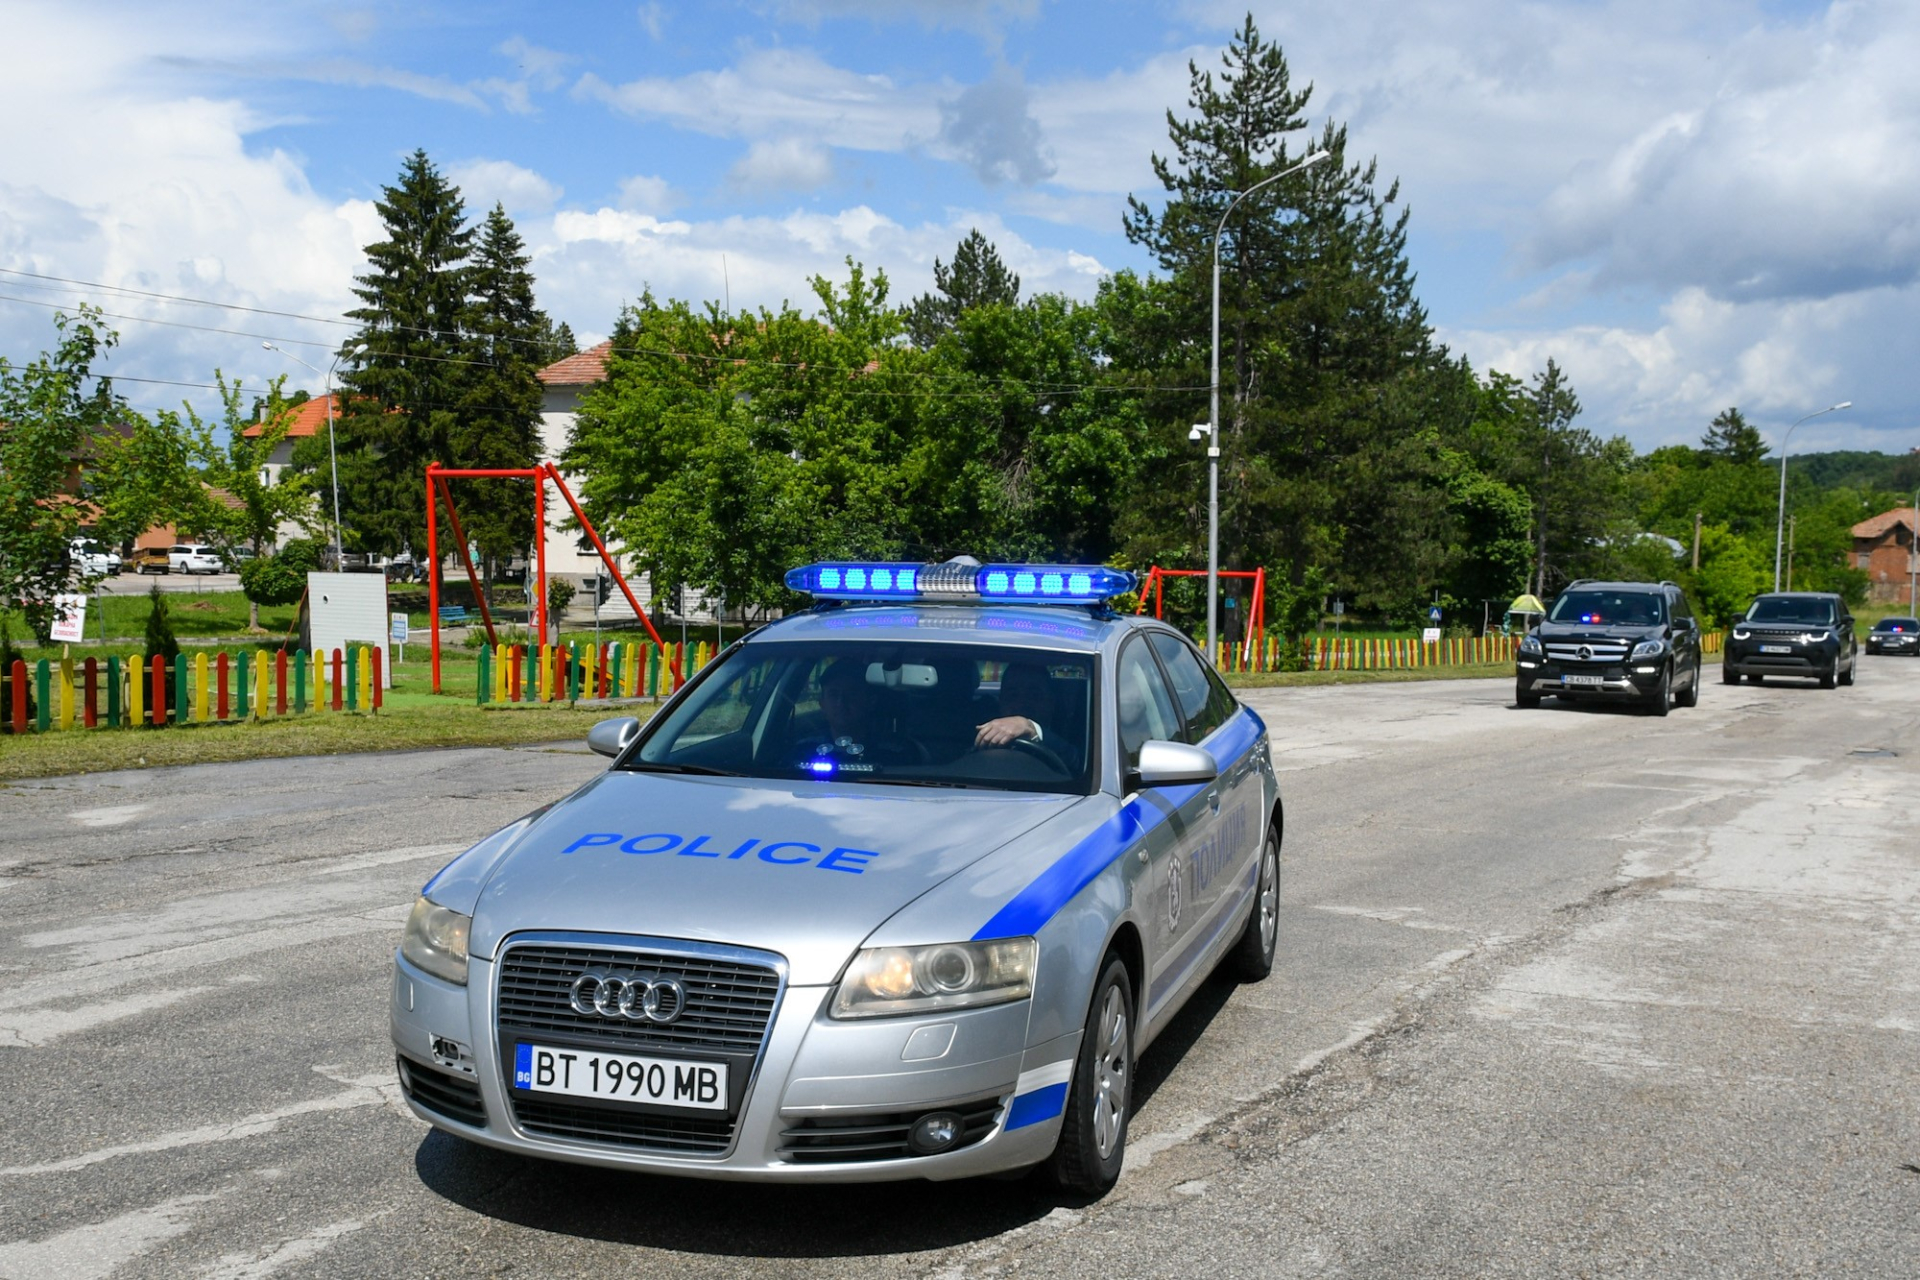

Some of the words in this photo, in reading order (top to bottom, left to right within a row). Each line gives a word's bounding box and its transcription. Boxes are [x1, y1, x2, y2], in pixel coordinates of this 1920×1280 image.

[561, 833, 880, 874] POLICE
[1190, 803, 1246, 902] ПОЛИЦИЯ
[517, 1072, 530, 1083] BG
[537, 1051, 577, 1088] BT
[589, 1058, 665, 1098] 1990
[673, 1065, 718, 1103] MB
